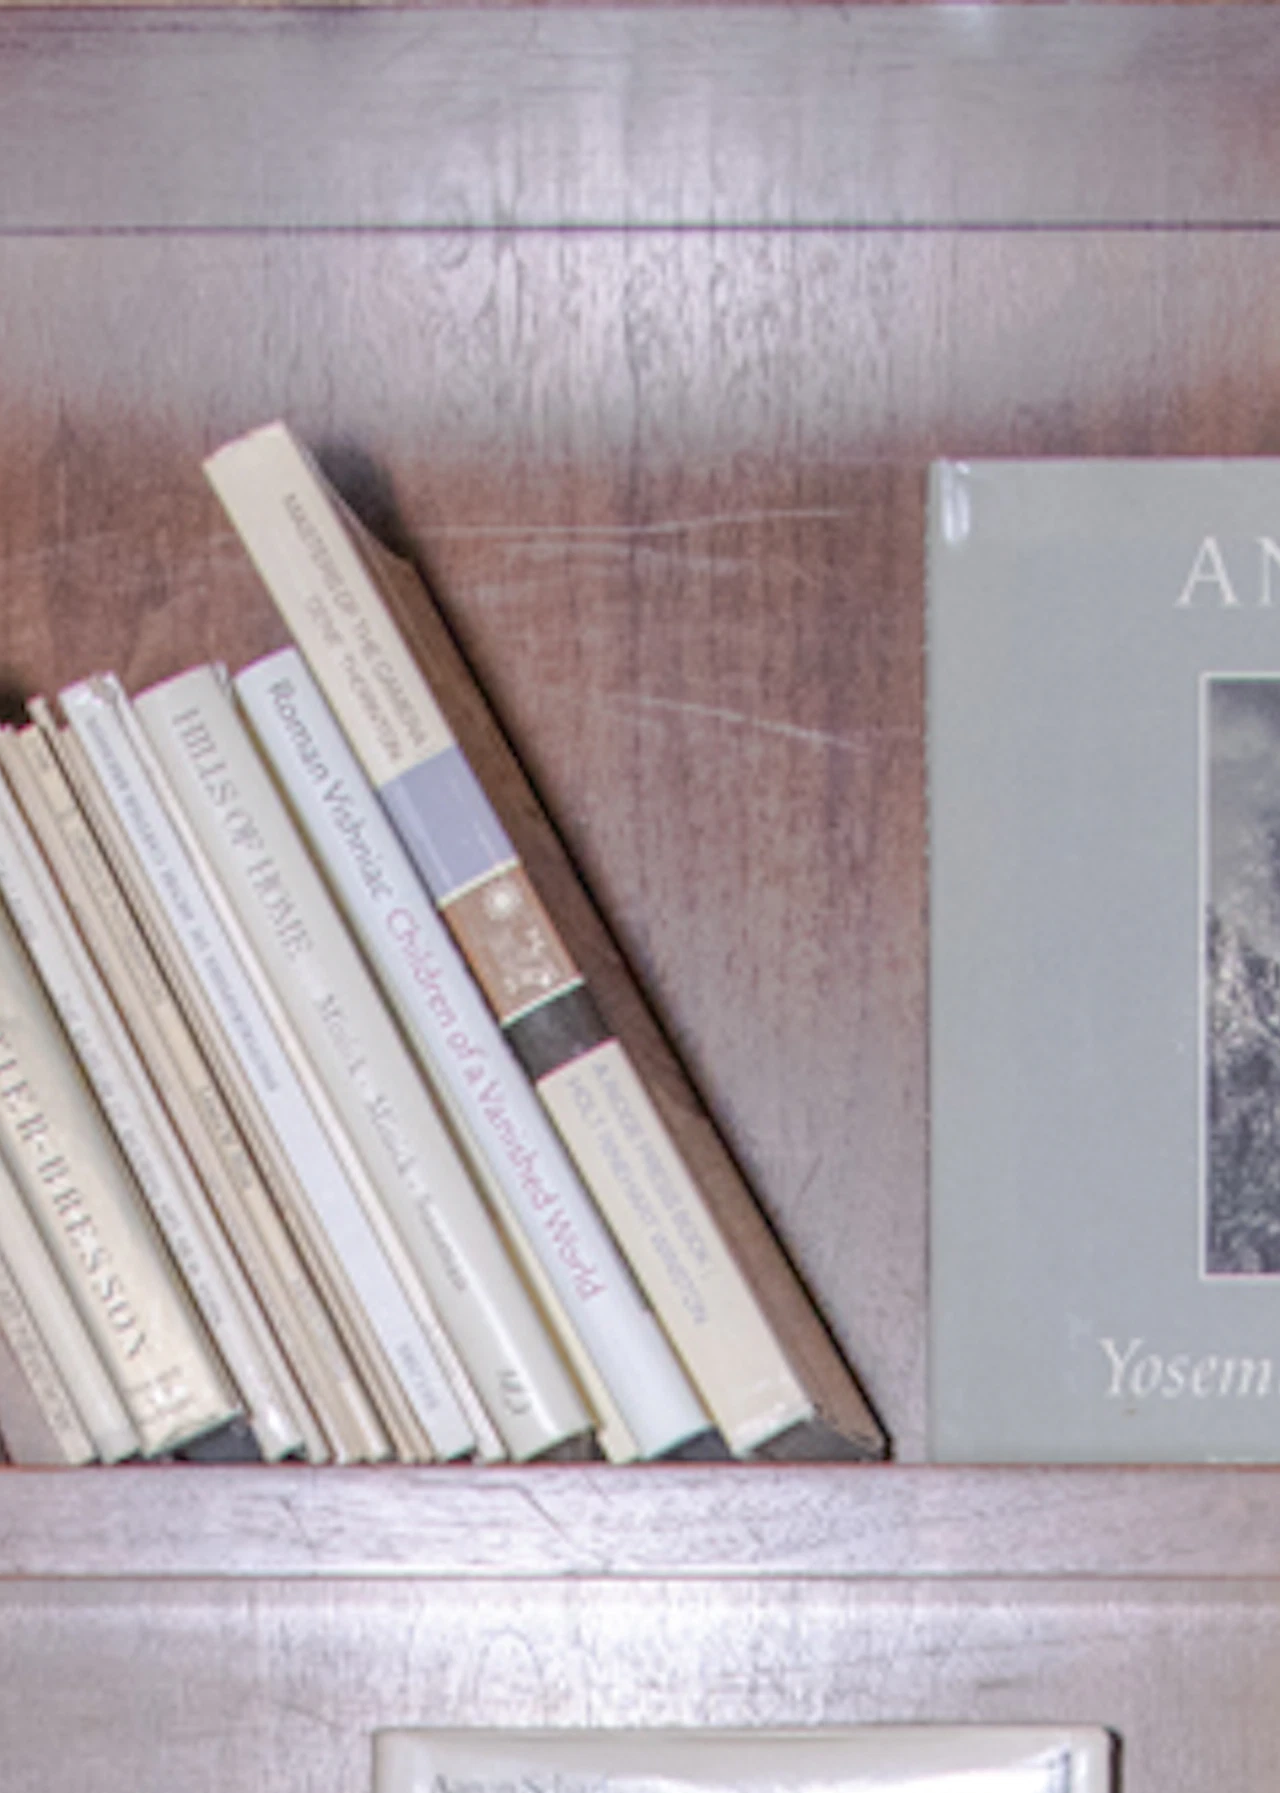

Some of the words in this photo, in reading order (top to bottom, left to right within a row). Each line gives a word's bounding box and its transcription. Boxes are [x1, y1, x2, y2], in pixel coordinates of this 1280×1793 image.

[167, 702, 242, 811] HILLS
[260, 674, 340, 786] Roman
[216, 803, 267, 862] OF
[313, 774, 403, 906] Vishniac
[241, 855, 316, 964] HOME
[379, 902, 469, 1033] Children
[443, 1024, 487, 1069] of
[459, 1060, 490, 1090] a
[471, 1080, 564, 1217] Vanished
[536, 1204, 608, 1304] World
